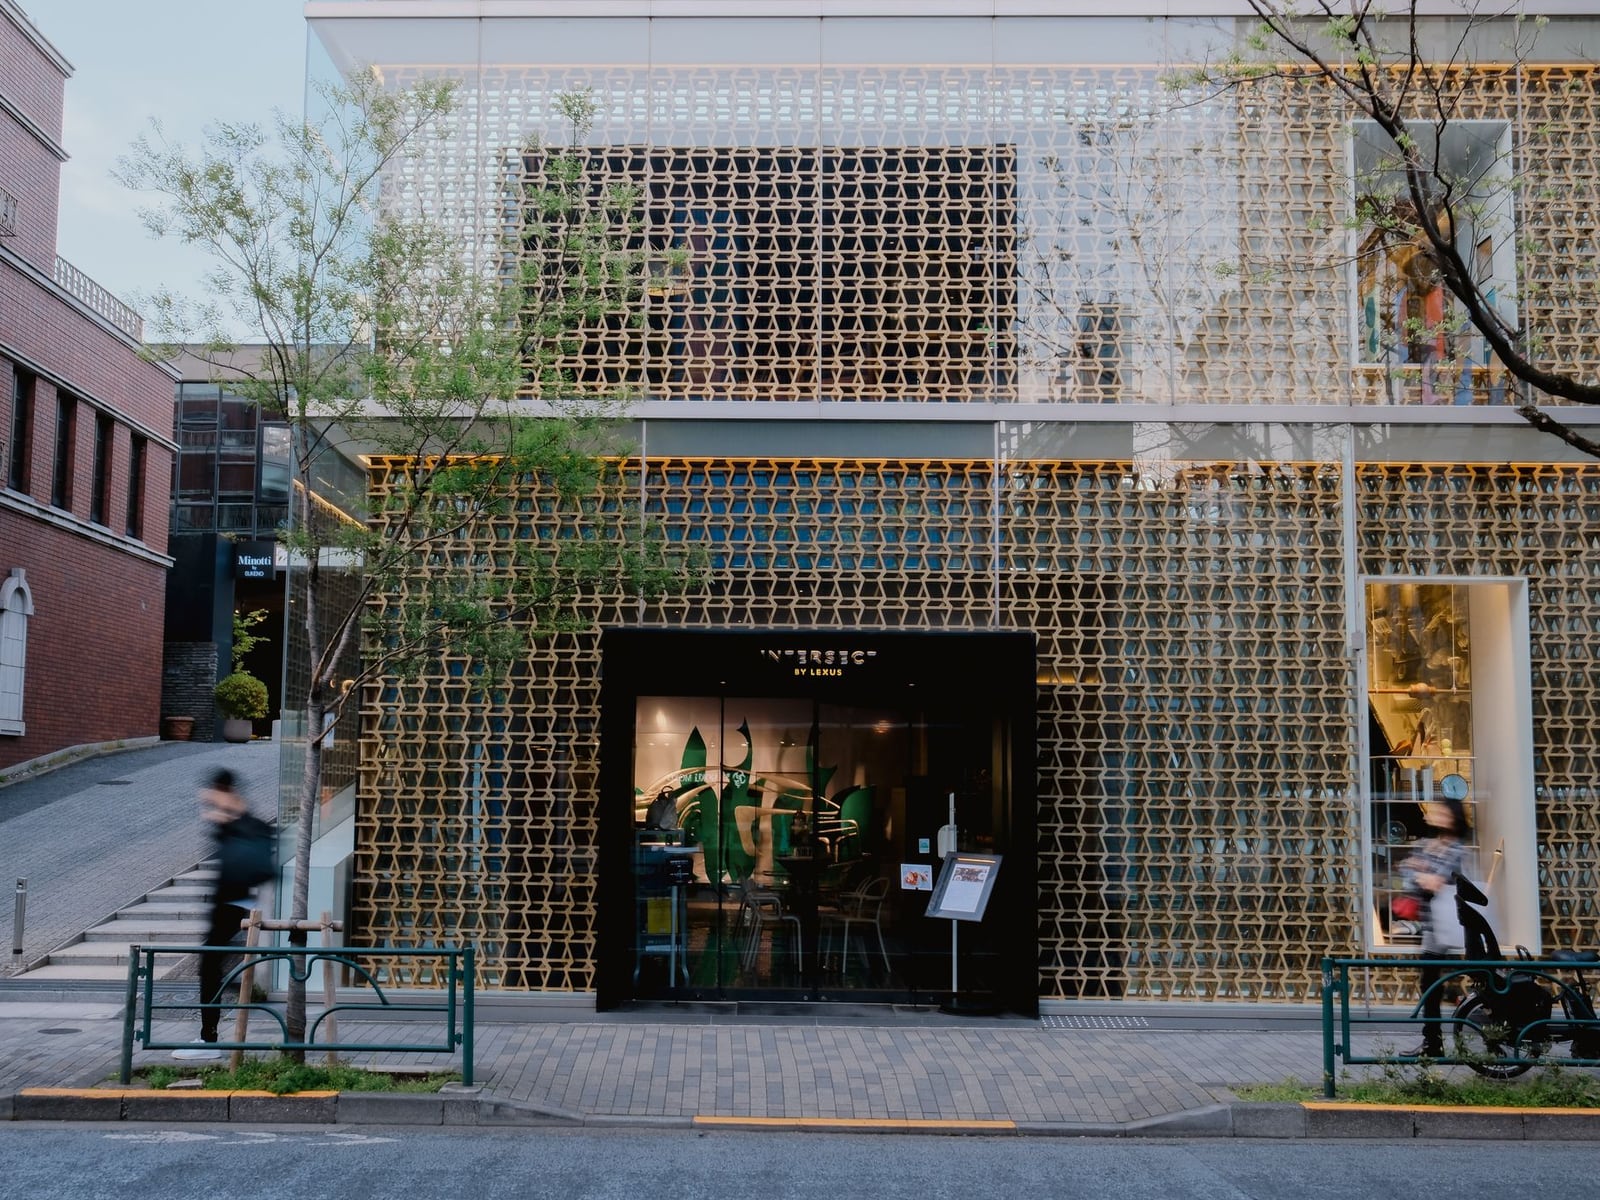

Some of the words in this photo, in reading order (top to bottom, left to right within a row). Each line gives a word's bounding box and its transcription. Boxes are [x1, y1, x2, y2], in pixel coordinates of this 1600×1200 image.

[238, 555, 272, 566] Minotti
[794, 668, 807, 676] BY
[810, 668, 843, 676] LEXUS
